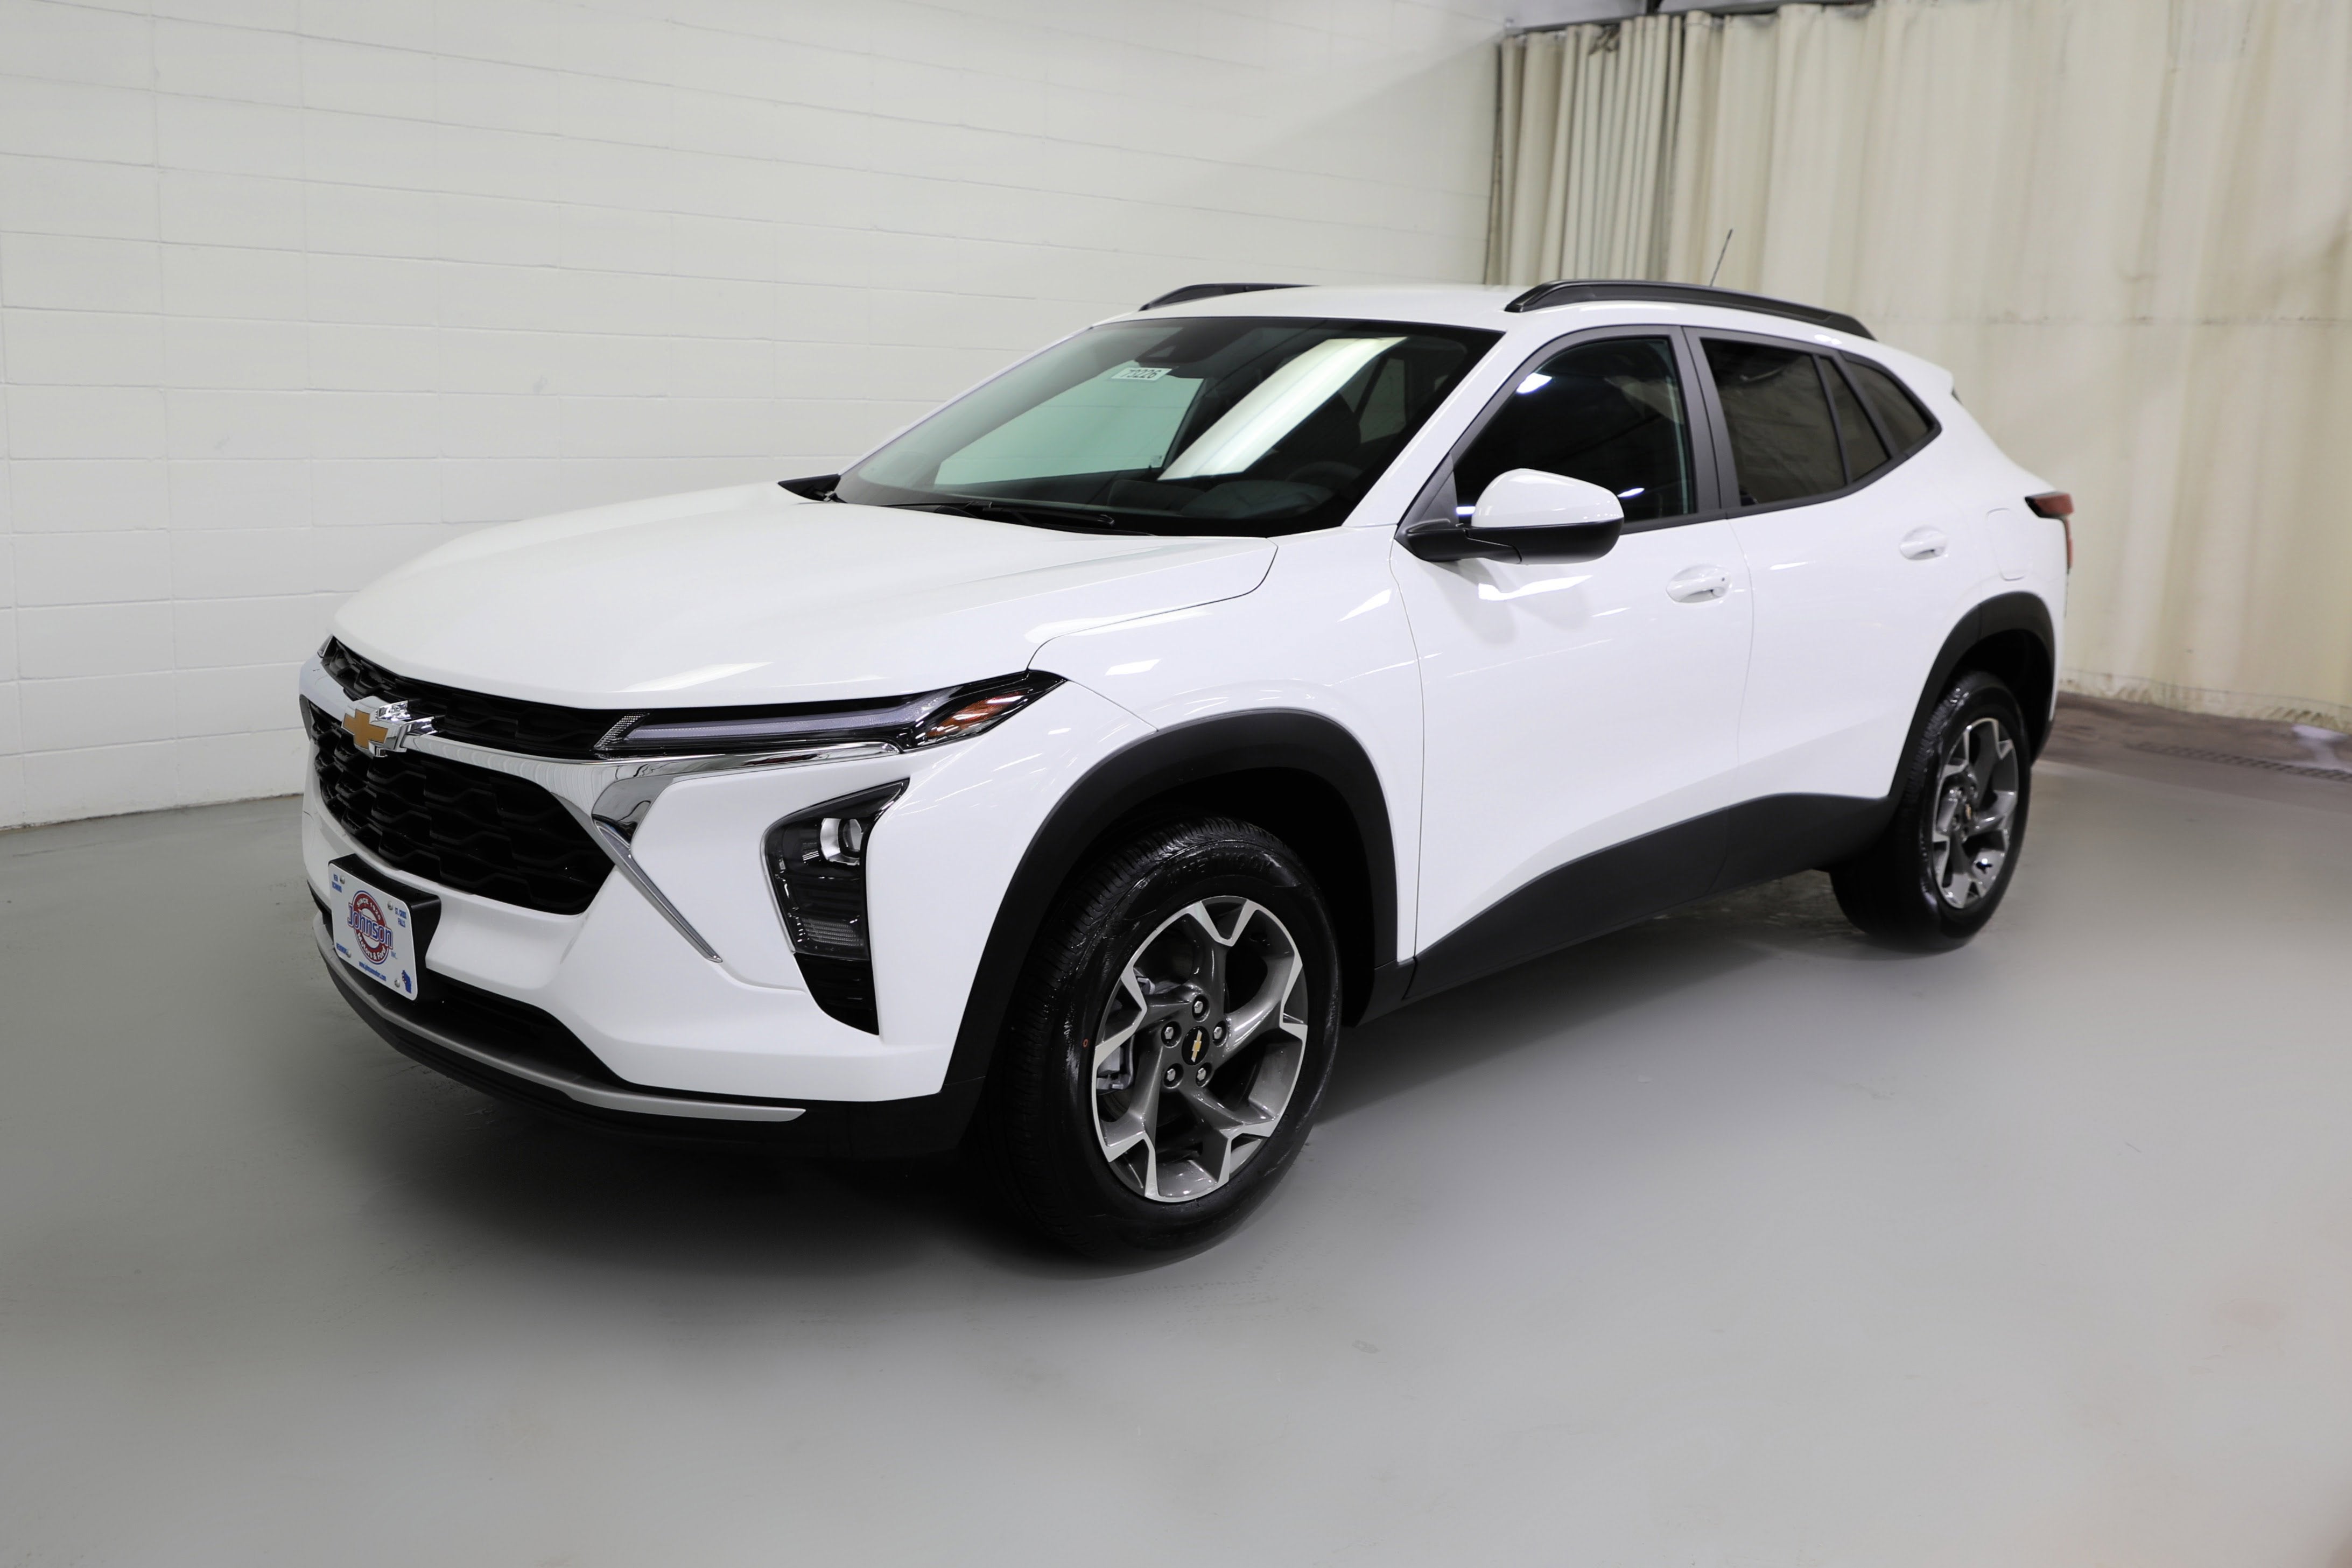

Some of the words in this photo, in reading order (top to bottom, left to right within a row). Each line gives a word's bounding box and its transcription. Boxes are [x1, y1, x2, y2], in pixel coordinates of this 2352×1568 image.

[357, 898, 369, 907] SINCE
[347, 902, 393, 950] Johnson
[357, 932, 373, 958] Motors
